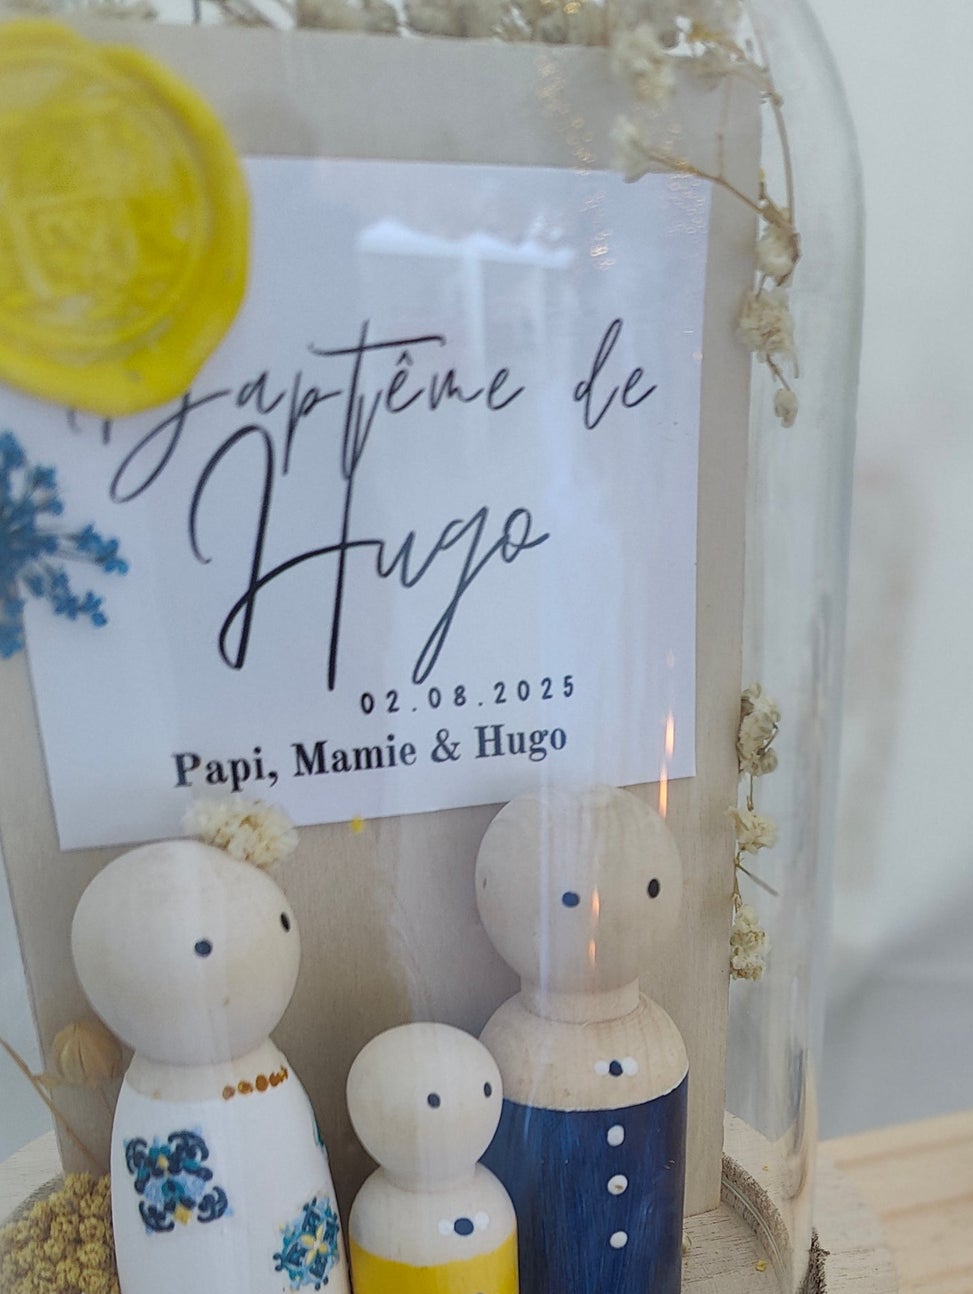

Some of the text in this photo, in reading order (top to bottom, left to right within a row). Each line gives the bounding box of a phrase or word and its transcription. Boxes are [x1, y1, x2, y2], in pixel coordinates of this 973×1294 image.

[572, 317, 658, 430] de
[187, 424, 551, 692] Hugo
[359, 674, 576, 715] 02.08.2025
[171, 720, 568, 793] Papi, Mamie & Hugo
